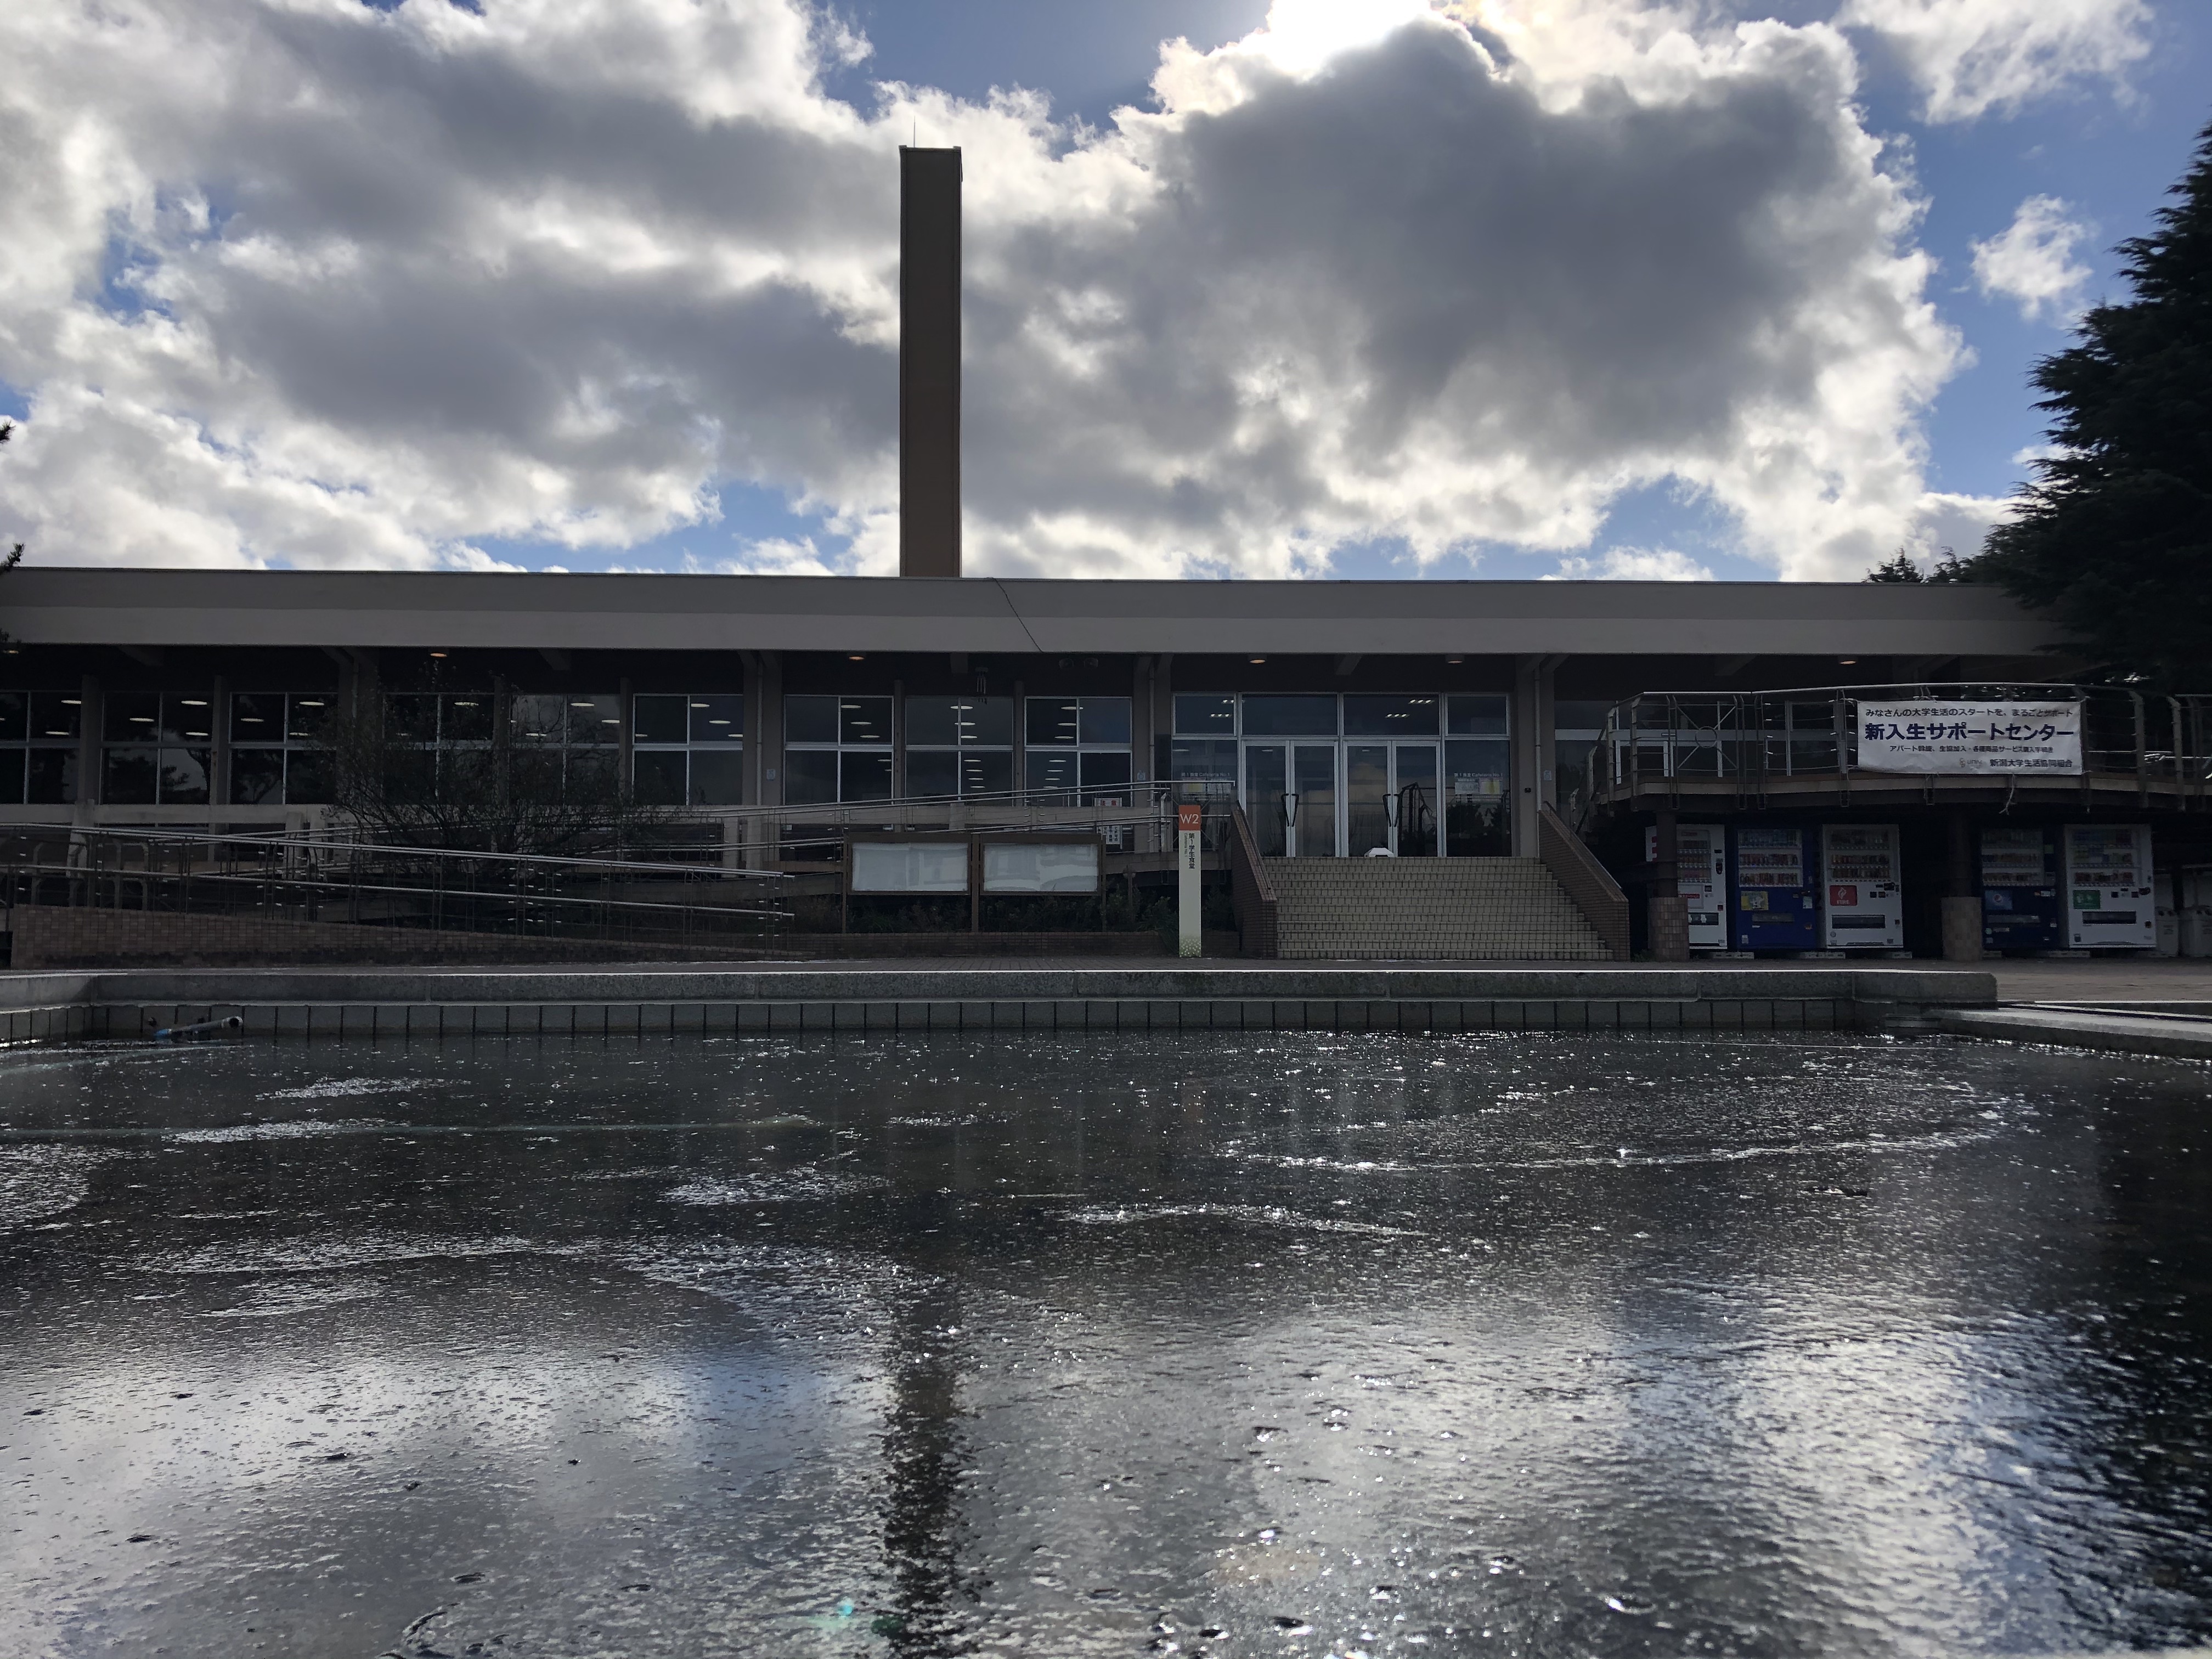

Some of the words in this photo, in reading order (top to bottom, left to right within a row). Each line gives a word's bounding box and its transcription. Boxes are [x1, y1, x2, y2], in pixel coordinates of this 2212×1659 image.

[1865, 708, 2073, 718] みなさんの大学生活のスタートを、まるごとサポート
[1865, 721, 2074, 741] 新入生サポートセンター
[1989, 759, 2073, 768] 新潟大学生活協同組合
[1180, 814, 1199, 824] W2
